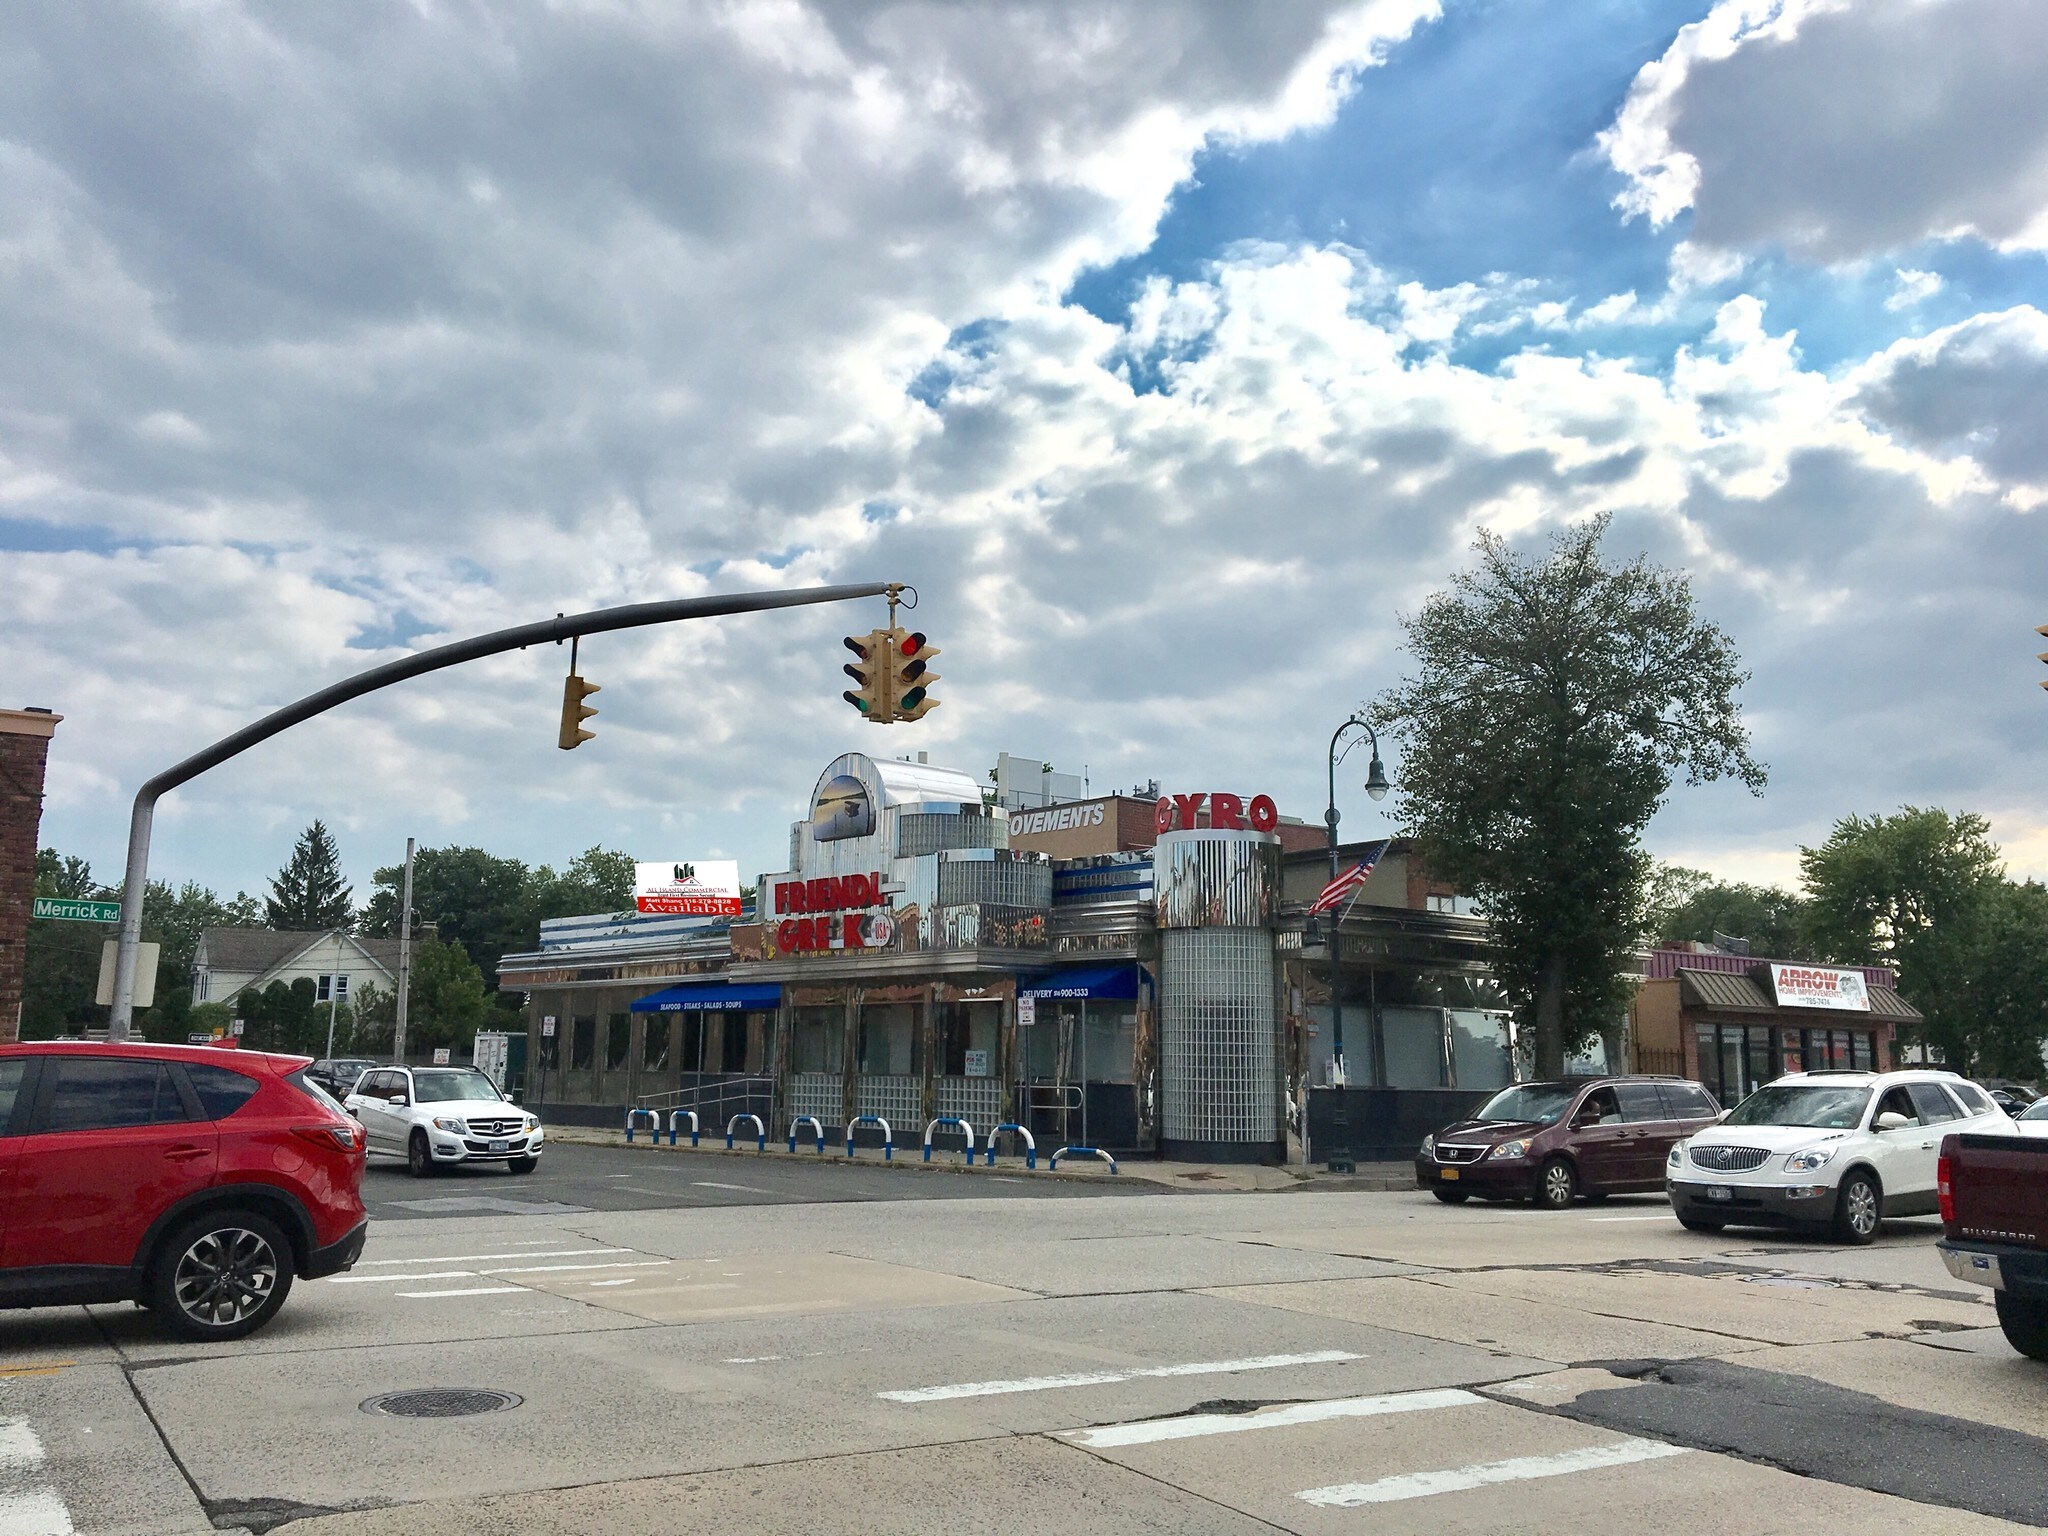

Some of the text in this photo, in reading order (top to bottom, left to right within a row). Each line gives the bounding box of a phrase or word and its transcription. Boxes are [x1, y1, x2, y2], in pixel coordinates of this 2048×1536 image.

[1008, 803, 1105, 837] OVEMENTS
[1154, 793, 1278, 834] GYRO
[36, 900, 118, 919] Merrick Rd
[644, 902, 737, 913] Available
[875, 922, 888, 940] USA
[1778, 968, 1839, 990] ARROW
[1023, 990, 1052, 998] DELIVERY
[1061, 988, 1088, 997] 900-1333
[1798, 989, 1842, 998] IMPROVEMENTS
[660, 1001, 742, 1011] SEAFOOD STEAKS SALADS SOUPS
